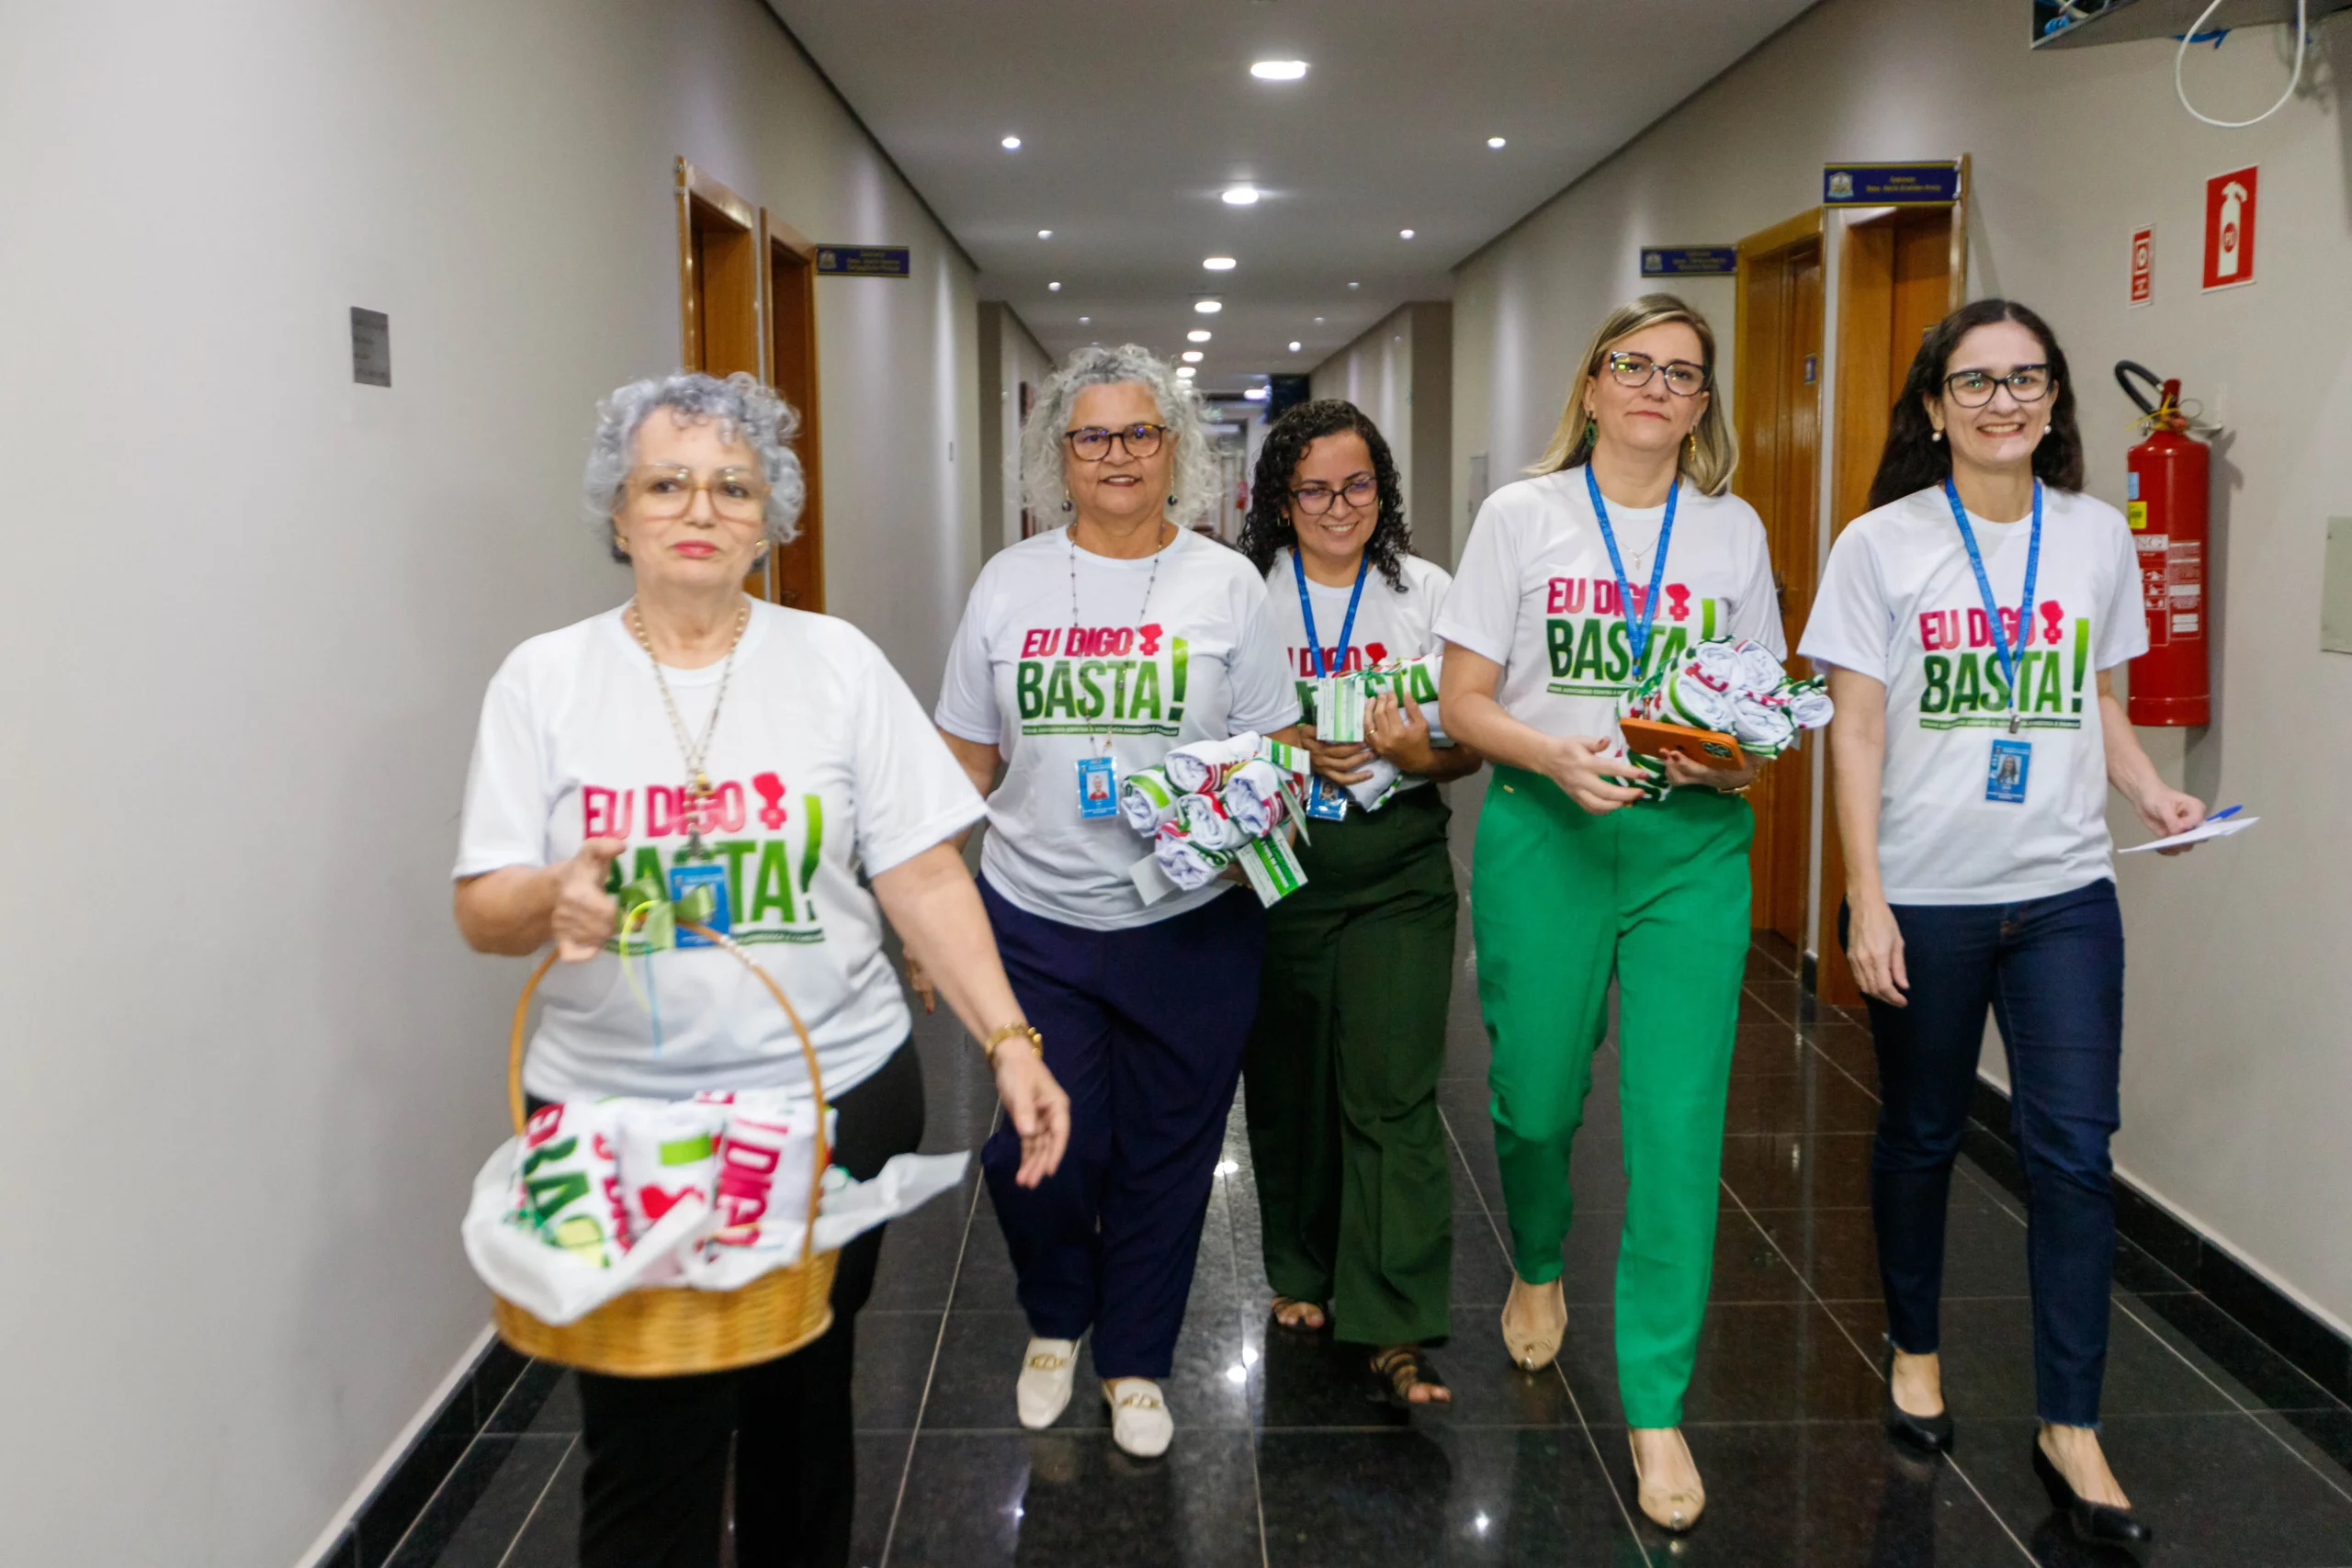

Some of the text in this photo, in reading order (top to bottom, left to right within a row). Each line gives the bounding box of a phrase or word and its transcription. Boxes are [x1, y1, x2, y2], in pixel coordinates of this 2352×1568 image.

[1546, 577, 1587, 614] EU
[1021, 626, 1135, 659] EU DIGO
[1546, 598, 1715, 682] BASTA
[1919, 609, 1961, 651] EU
[1017, 636, 1189, 722] BASTA!
[582, 780, 746, 840] EU DIGO
